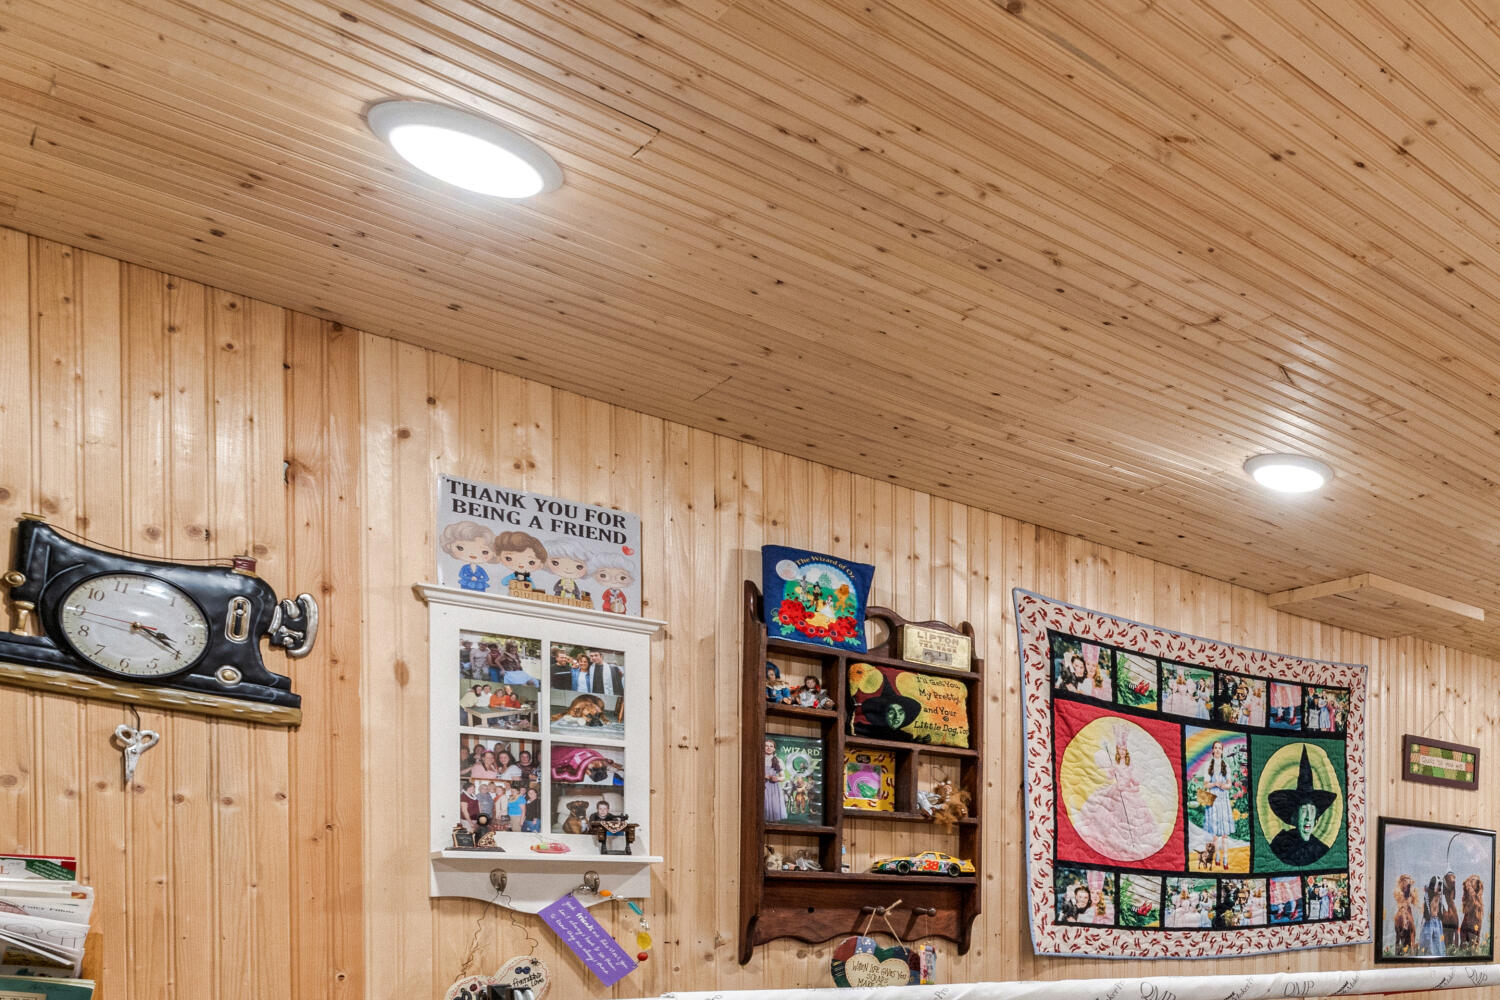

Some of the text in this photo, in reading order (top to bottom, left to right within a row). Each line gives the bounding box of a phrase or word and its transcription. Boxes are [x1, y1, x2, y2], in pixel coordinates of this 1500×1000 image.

[446, 478, 627, 530] THANK YOU FOR
[451, 498, 627, 545] BEING A FRIEND
[796, 557, 810, 566] The
[811, 555, 838, 566] Wizard
[113, 581, 129, 594] 11
[87, 588, 106, 602] 10
[169, 596, 177, 608] 1
[72, 603, 86, 617] 9
[184, 614, 196, 626] 2
[77, 624, 90, 638] 8
[184, 634, 196, 647] 3
[917, 631, 959, 647] LIPTON
[94, 643, 106, 656] 7
[119, 657, 131, 670] 6
[147, 658, 160, 670] 5
[919, 688, 932, 701] My
[923, 706, 957, 717] and Your
[913, 721, 942, 731] Little
[782, 745, 820, 757] WIZARD
[923, 859, 940, 871] 38
